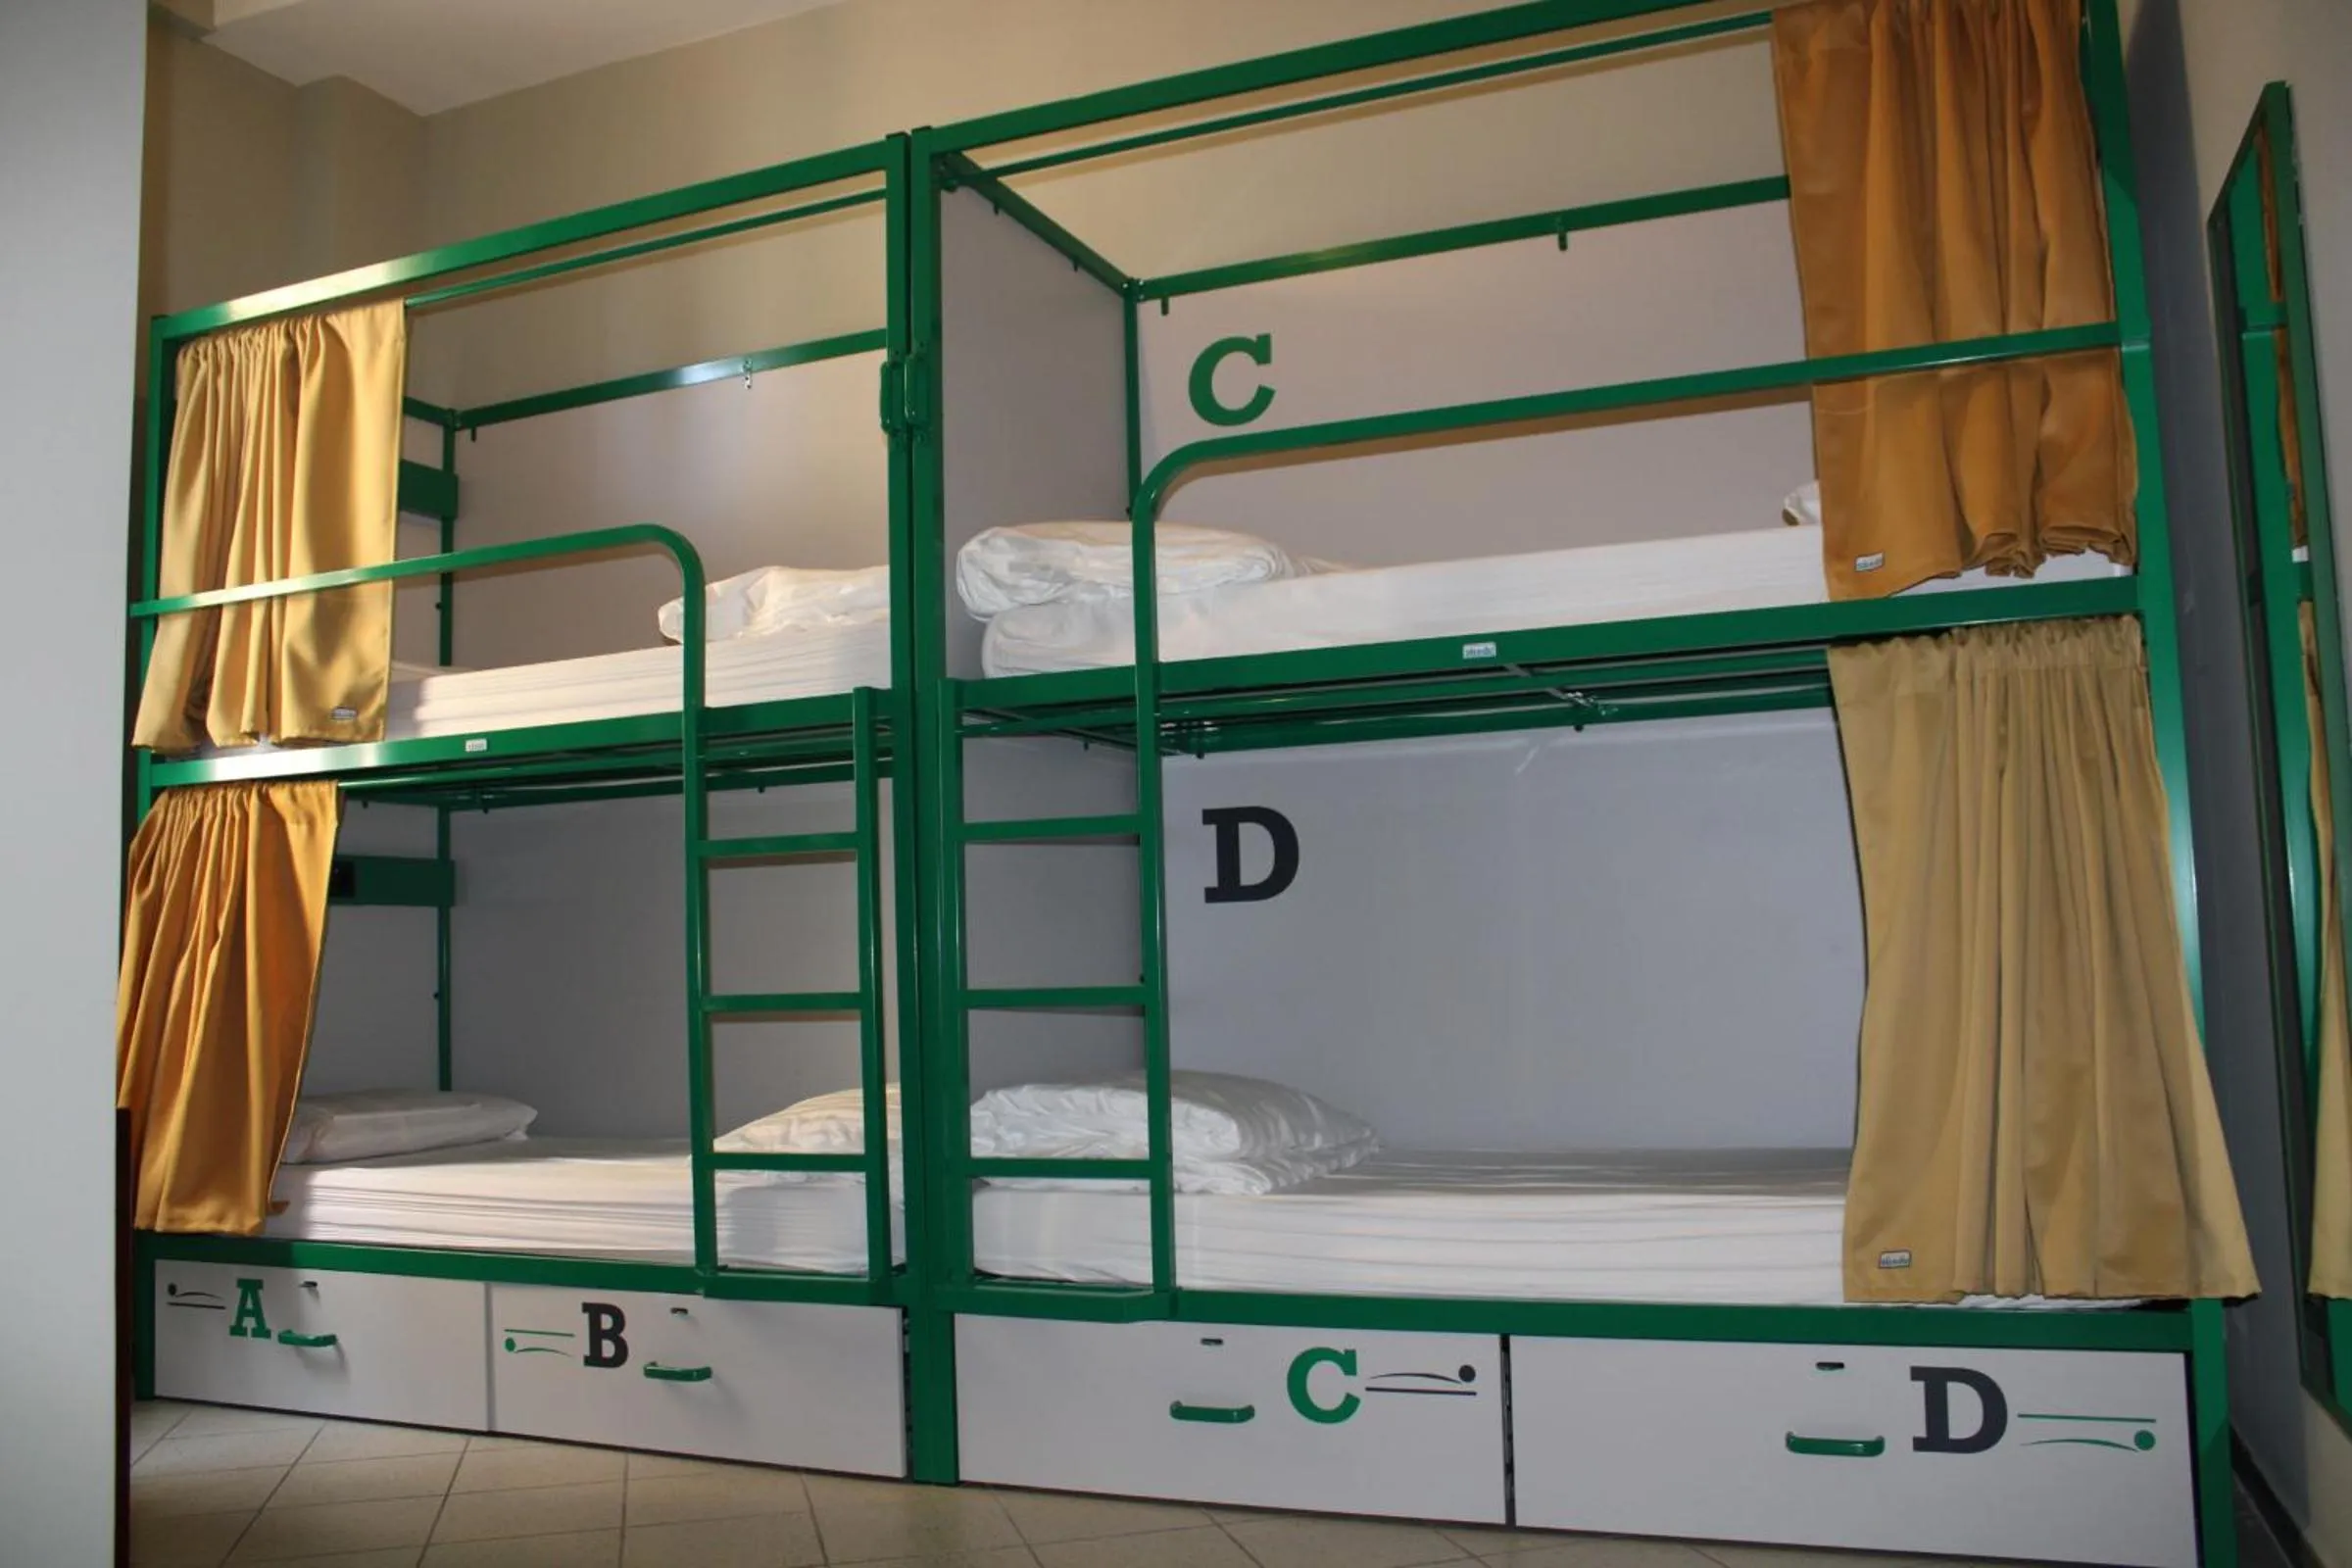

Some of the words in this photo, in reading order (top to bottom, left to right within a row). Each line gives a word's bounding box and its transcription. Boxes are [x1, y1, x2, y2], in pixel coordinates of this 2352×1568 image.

[1189, 334, 1275, 425] C
[1201, 806, 1299, 904] D
[229, 1279, 271, 1339] A
[581, 1301, 628, 1368] B
[1287, 1347, 1360, 1424] C
[1910, 1366, 2007, 1453] D
